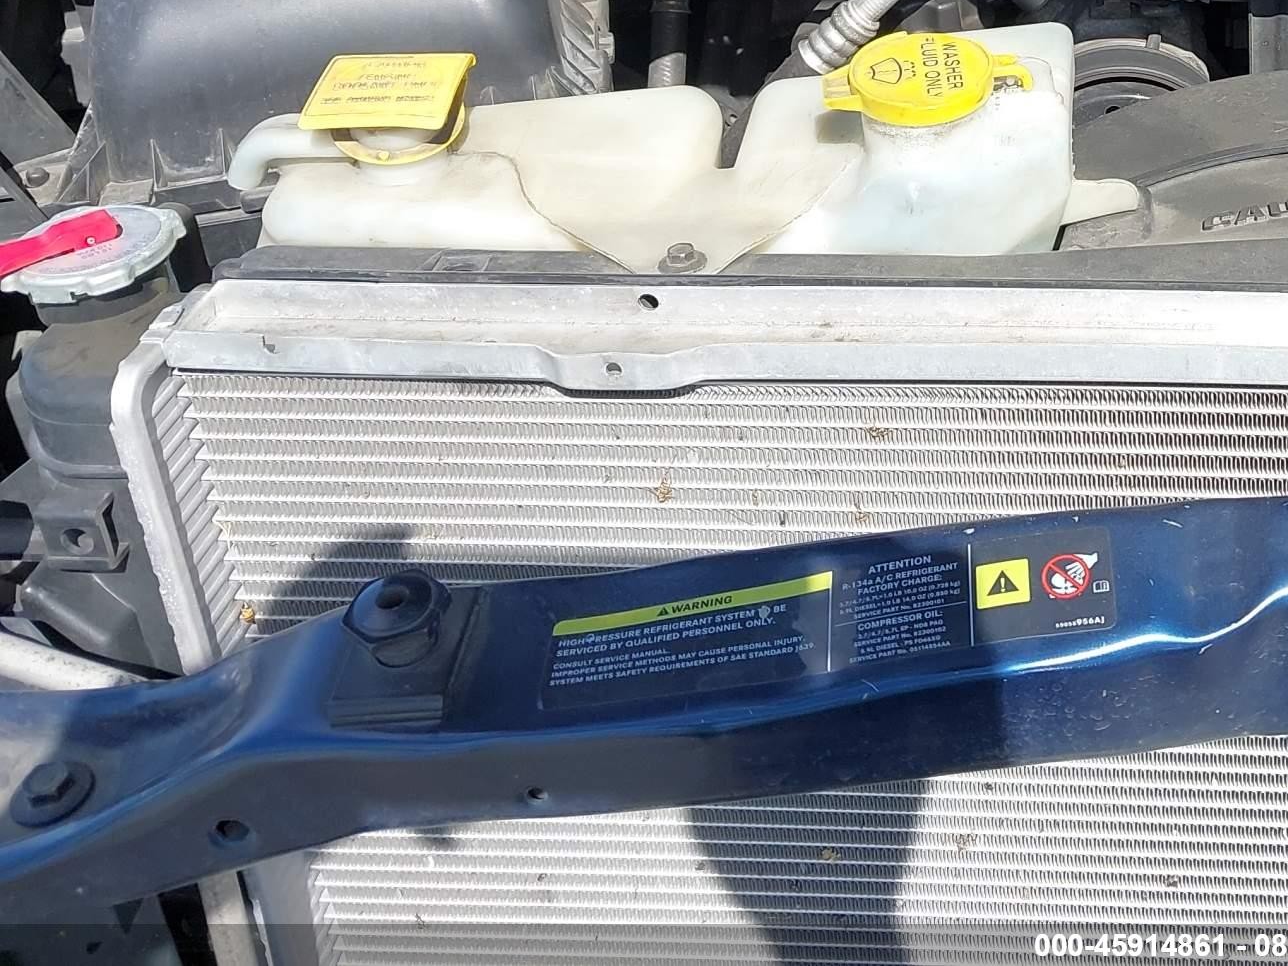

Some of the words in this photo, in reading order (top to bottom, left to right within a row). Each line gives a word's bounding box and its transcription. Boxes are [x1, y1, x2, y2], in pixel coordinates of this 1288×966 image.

[941, 41, 964, 90] WASHER
[924, 70, 944, 98] ONLY
[842, 578, 874, 591] R-134a
[875, 573, 894, 585] A/C
[895, 562, 959, 580] REFRIGERANT
[868, 554, 932, 574] ATTENTION
[857, 581, 900, 596] FACTORY
[901, 574, 943, 588] CHARGE:
[671, 595, 733, 614] WARNING
[558, 638, 585, 647] HIGH
[643, 615, 713, 634] REFRIGERANT
[715, 609, 756, 625] SYSTEM
[773, 604, 787, 613] BE
[857, 613, 922, 631] COMPRESSOR
[924, 609, 944, 619] OIL:
[556, 644, 607, 657] SERVICED
[609, 641, 623, 651] BY
[625, 630, 680, 649] QUALIFIED
[682, 621, 743, 639] PERSONNEL
[745, 616, 776, 629] ONLY.
[550, 676, 584, 687] SYSTEM
[585, 673, 615, 683] MEETS
[615, 667, 648, 678] SAFETY
[649, 656, 715, 673] REQUIREMENTS
[717, 654, 729, 664] OF
[729, 651, 747, 662] SAE
[748, 645, 793, 660] STANDARD
[551, 667, 596, 678] IMPROPER
[597, 660, 634, 673] SERVICE
[635, 654, 678, 668] METHODS
[679, 650, 696, 661] MAY
[698, 645, 726, 657] CAUSE
[728, 639, 772, 653] PERSONAL
[553, 659, 593, 670] CONSULT
[594, 653, 630, 664] SERVICE
